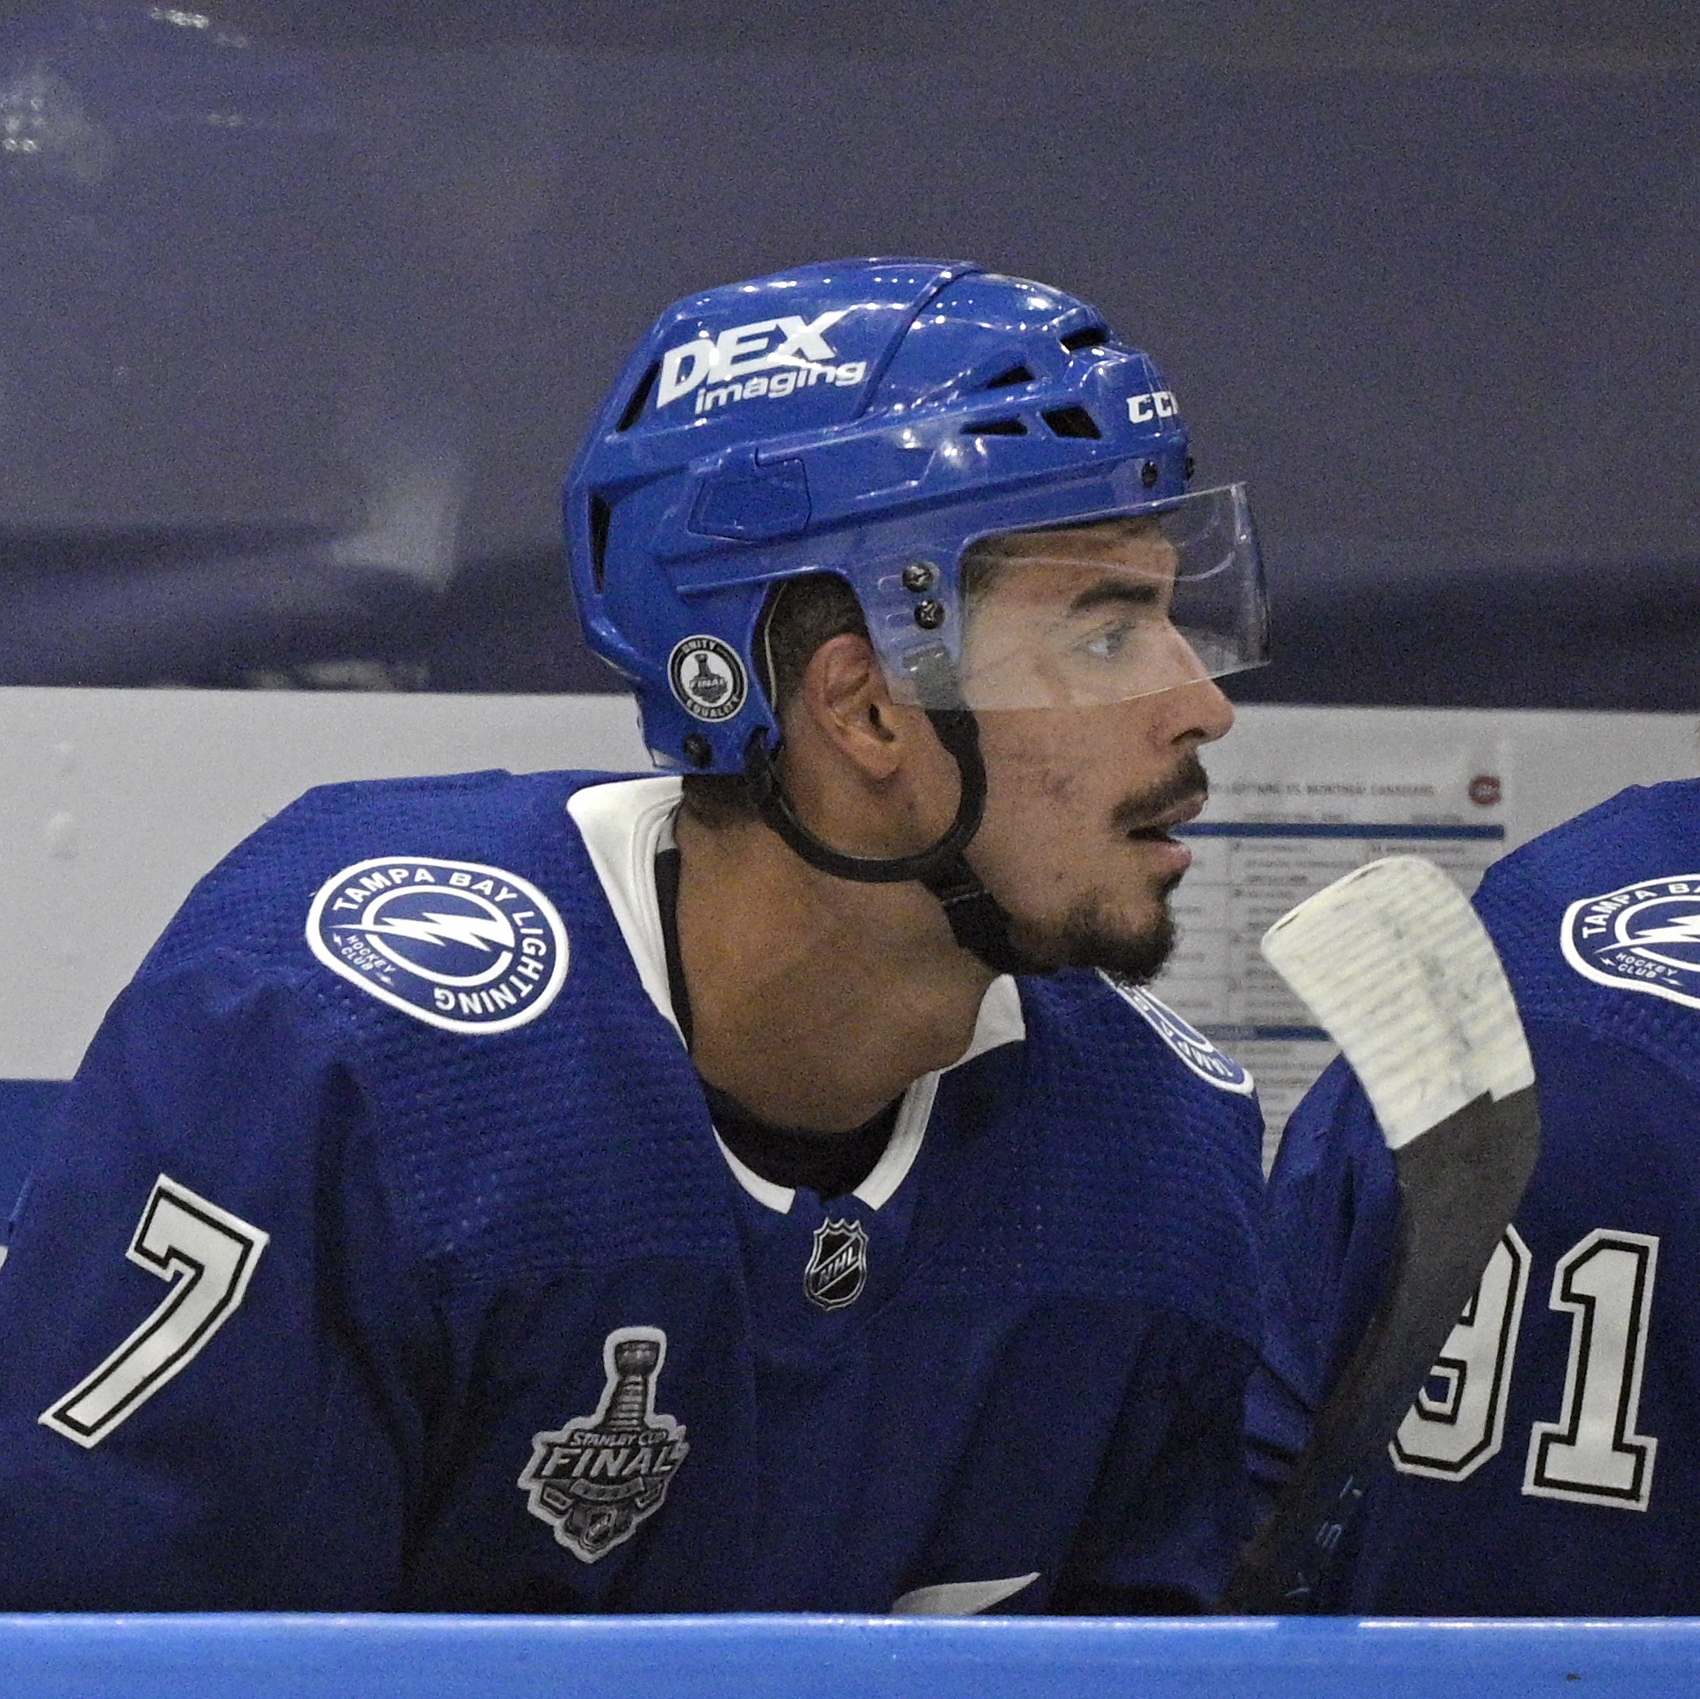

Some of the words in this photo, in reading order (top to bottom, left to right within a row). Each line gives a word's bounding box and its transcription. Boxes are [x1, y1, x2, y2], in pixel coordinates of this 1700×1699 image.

[656, 310, 845, 409] DEX
[695, 360, 867, 415] imaging
[333, 868, 435, 912] TAMPA
[449, 871, 518, 902] BAY
[1582, 889, 1658, 939] TAMPA
[340, 946, 376, 972] CLUB
[346, 935, 396, 974] HOCKEY
[434, 910, 547, 1015] LIGHTNING
[1615, 952, 1678, 977] HOCKEY
[1617, 963, 1657, 978] CLUB
[818, 1245, 858, 1288] NHL
[38, 1171, 270, 1450] 7
[1387, 1222, 1660, 1513] 91
[570, 1431, 636, 1447] STANLEY
[541, 1446, 675, 1479] FINAL
